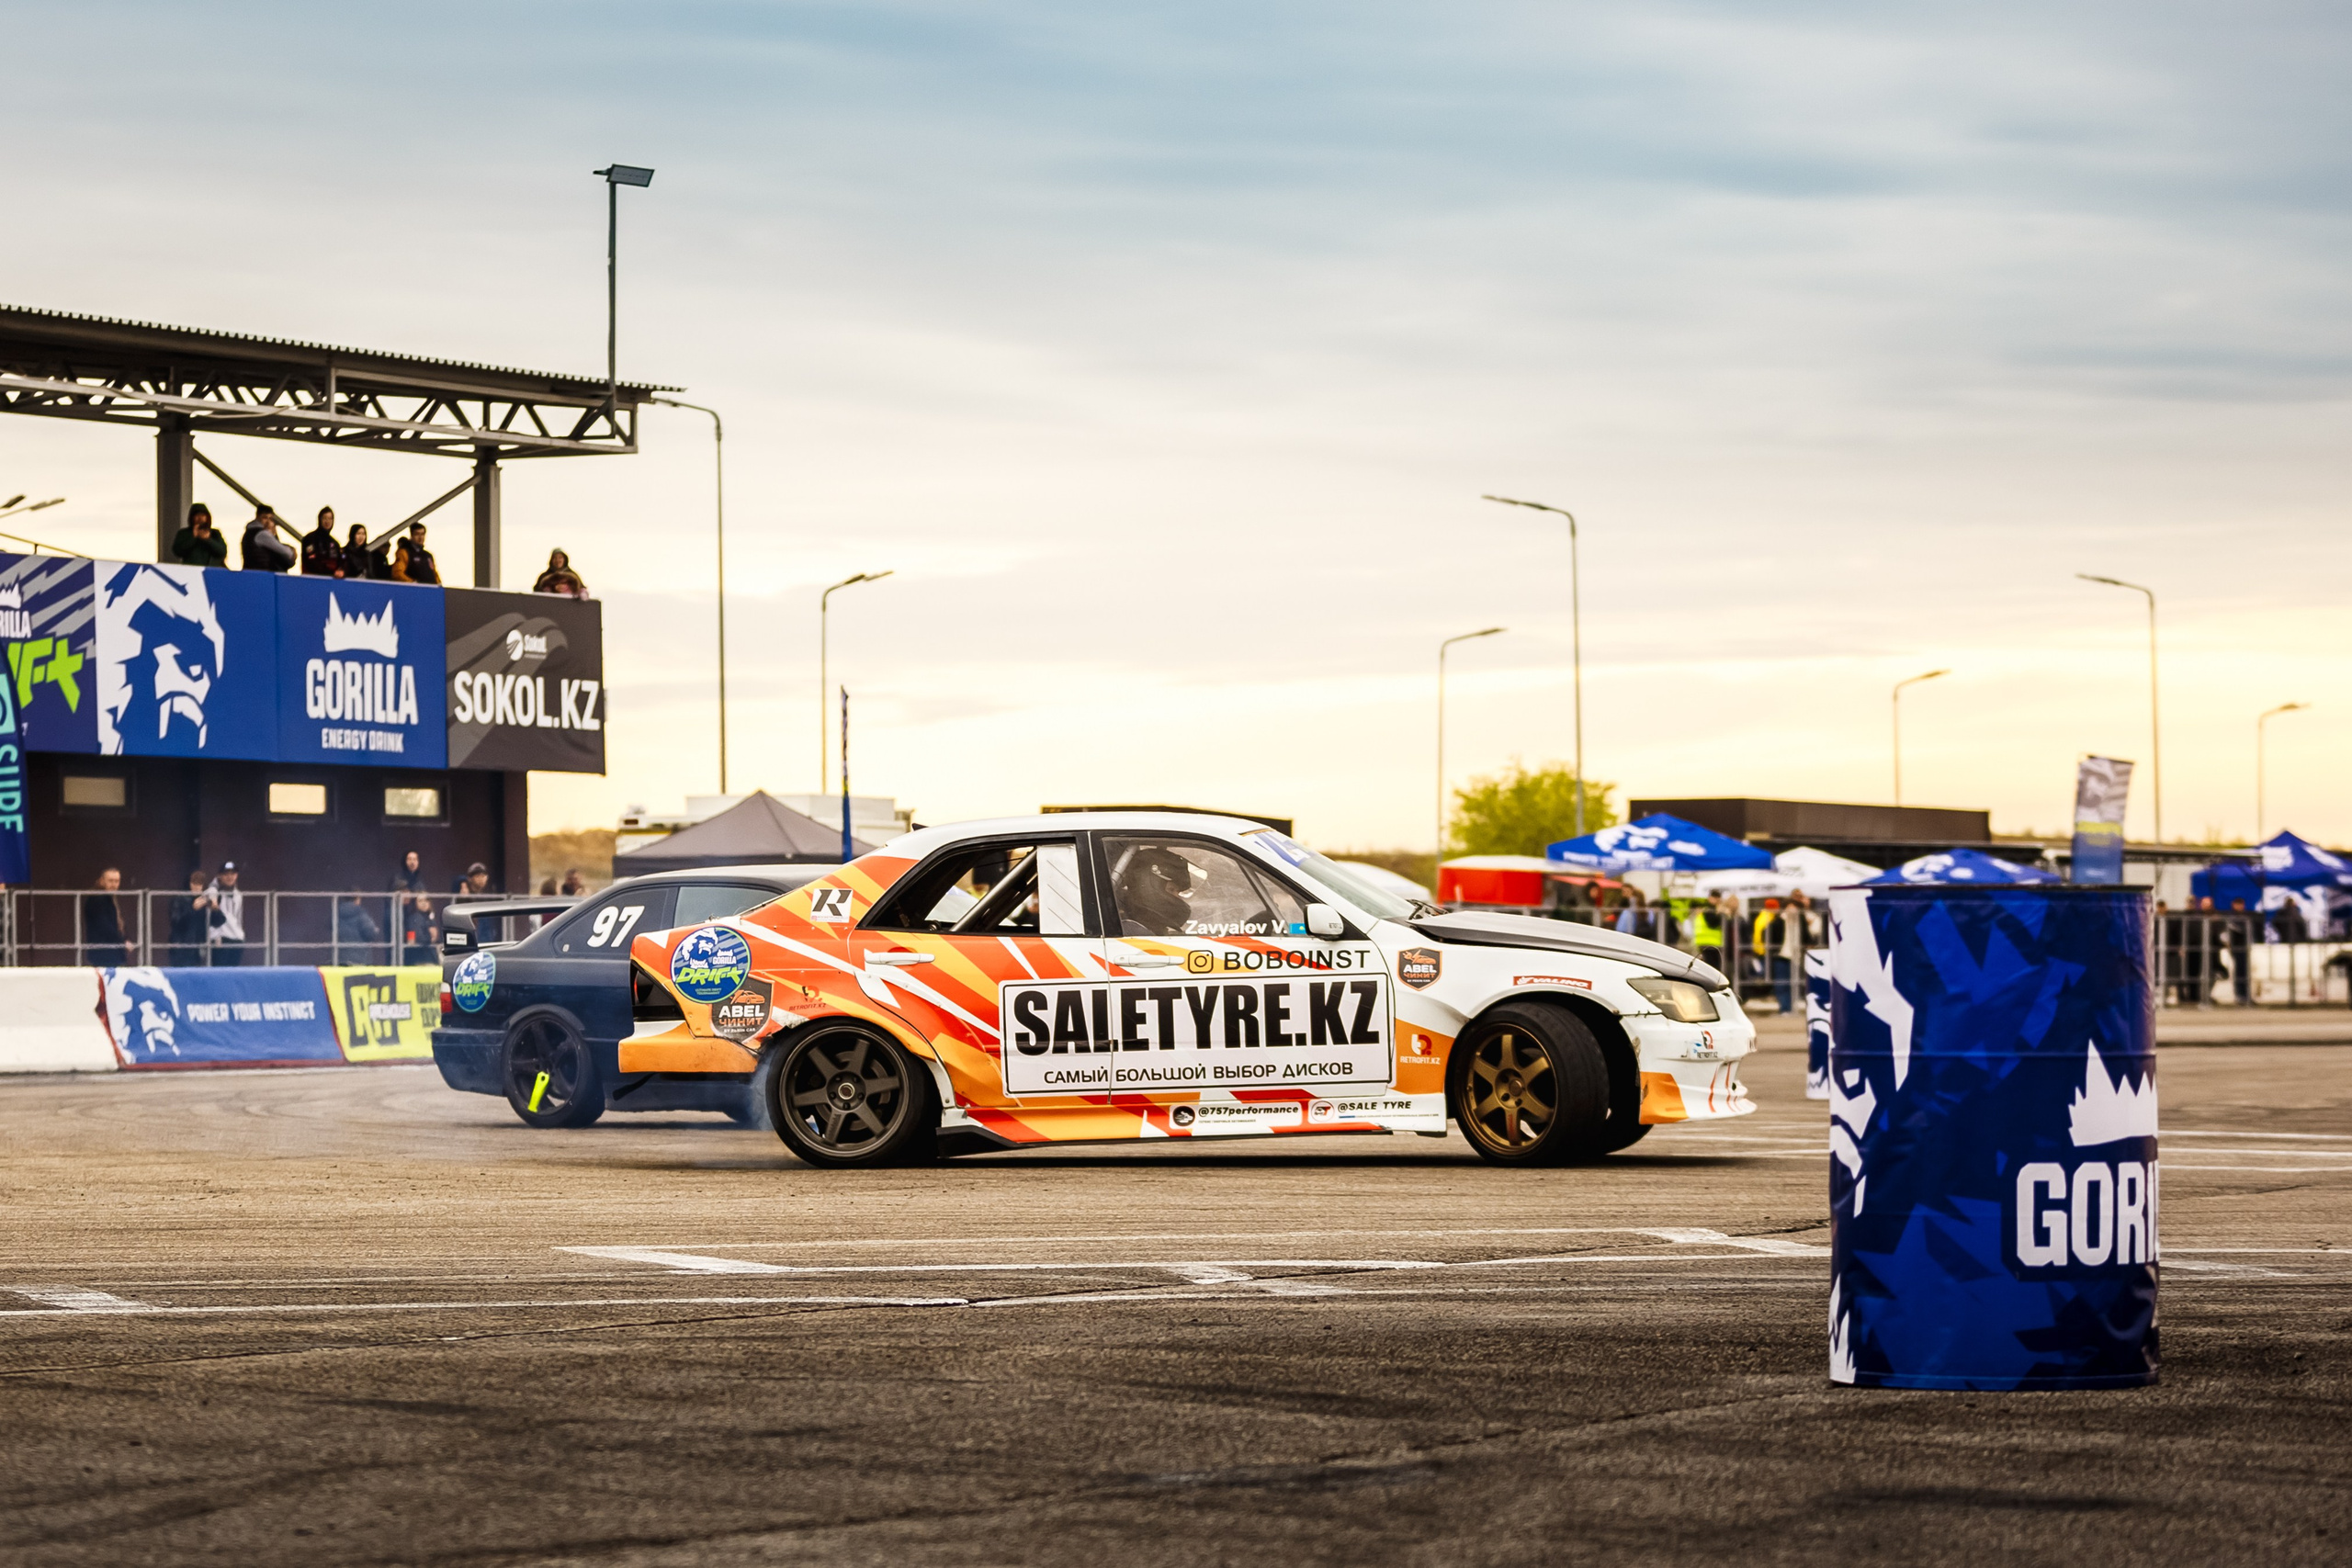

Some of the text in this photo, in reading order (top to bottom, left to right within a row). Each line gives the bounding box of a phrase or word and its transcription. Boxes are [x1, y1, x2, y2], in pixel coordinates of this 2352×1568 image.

[306, 658, 419, 726] GORILLA
[454, 671, 601, 731] SOKOL.KZ
[322, 728, 404, 753] ENERGY DRINK
[587, 905, 645, 948] 97
[1184, 919, 1288, 937] Zavyalov V.
[712, 955, 737, 965] GORILLA
[1224, 949, 1371, 971] BOBOINST
[1403, 964, 1437, 974] ABEL
[1533, 977, 1589, 988] VALINO
[187, 1000, 316, 1022] POWER YOUR INSTINCT
[718, 1005, 765, 1019] ABEL
[1012, 980, 1380, 1056] SALETYRE.KZ
[718, 1017, 763, 1027] ЧИНИТ
[1399, 1055, 1441, 1066] RETROFIT.KZ
[1044, 1061, 1353, 1085] САМЫЙ БОЛЬШОЙ ВЫБОР ДИСКОВ
[1198, 1105, 1299, 1117] @757performance
